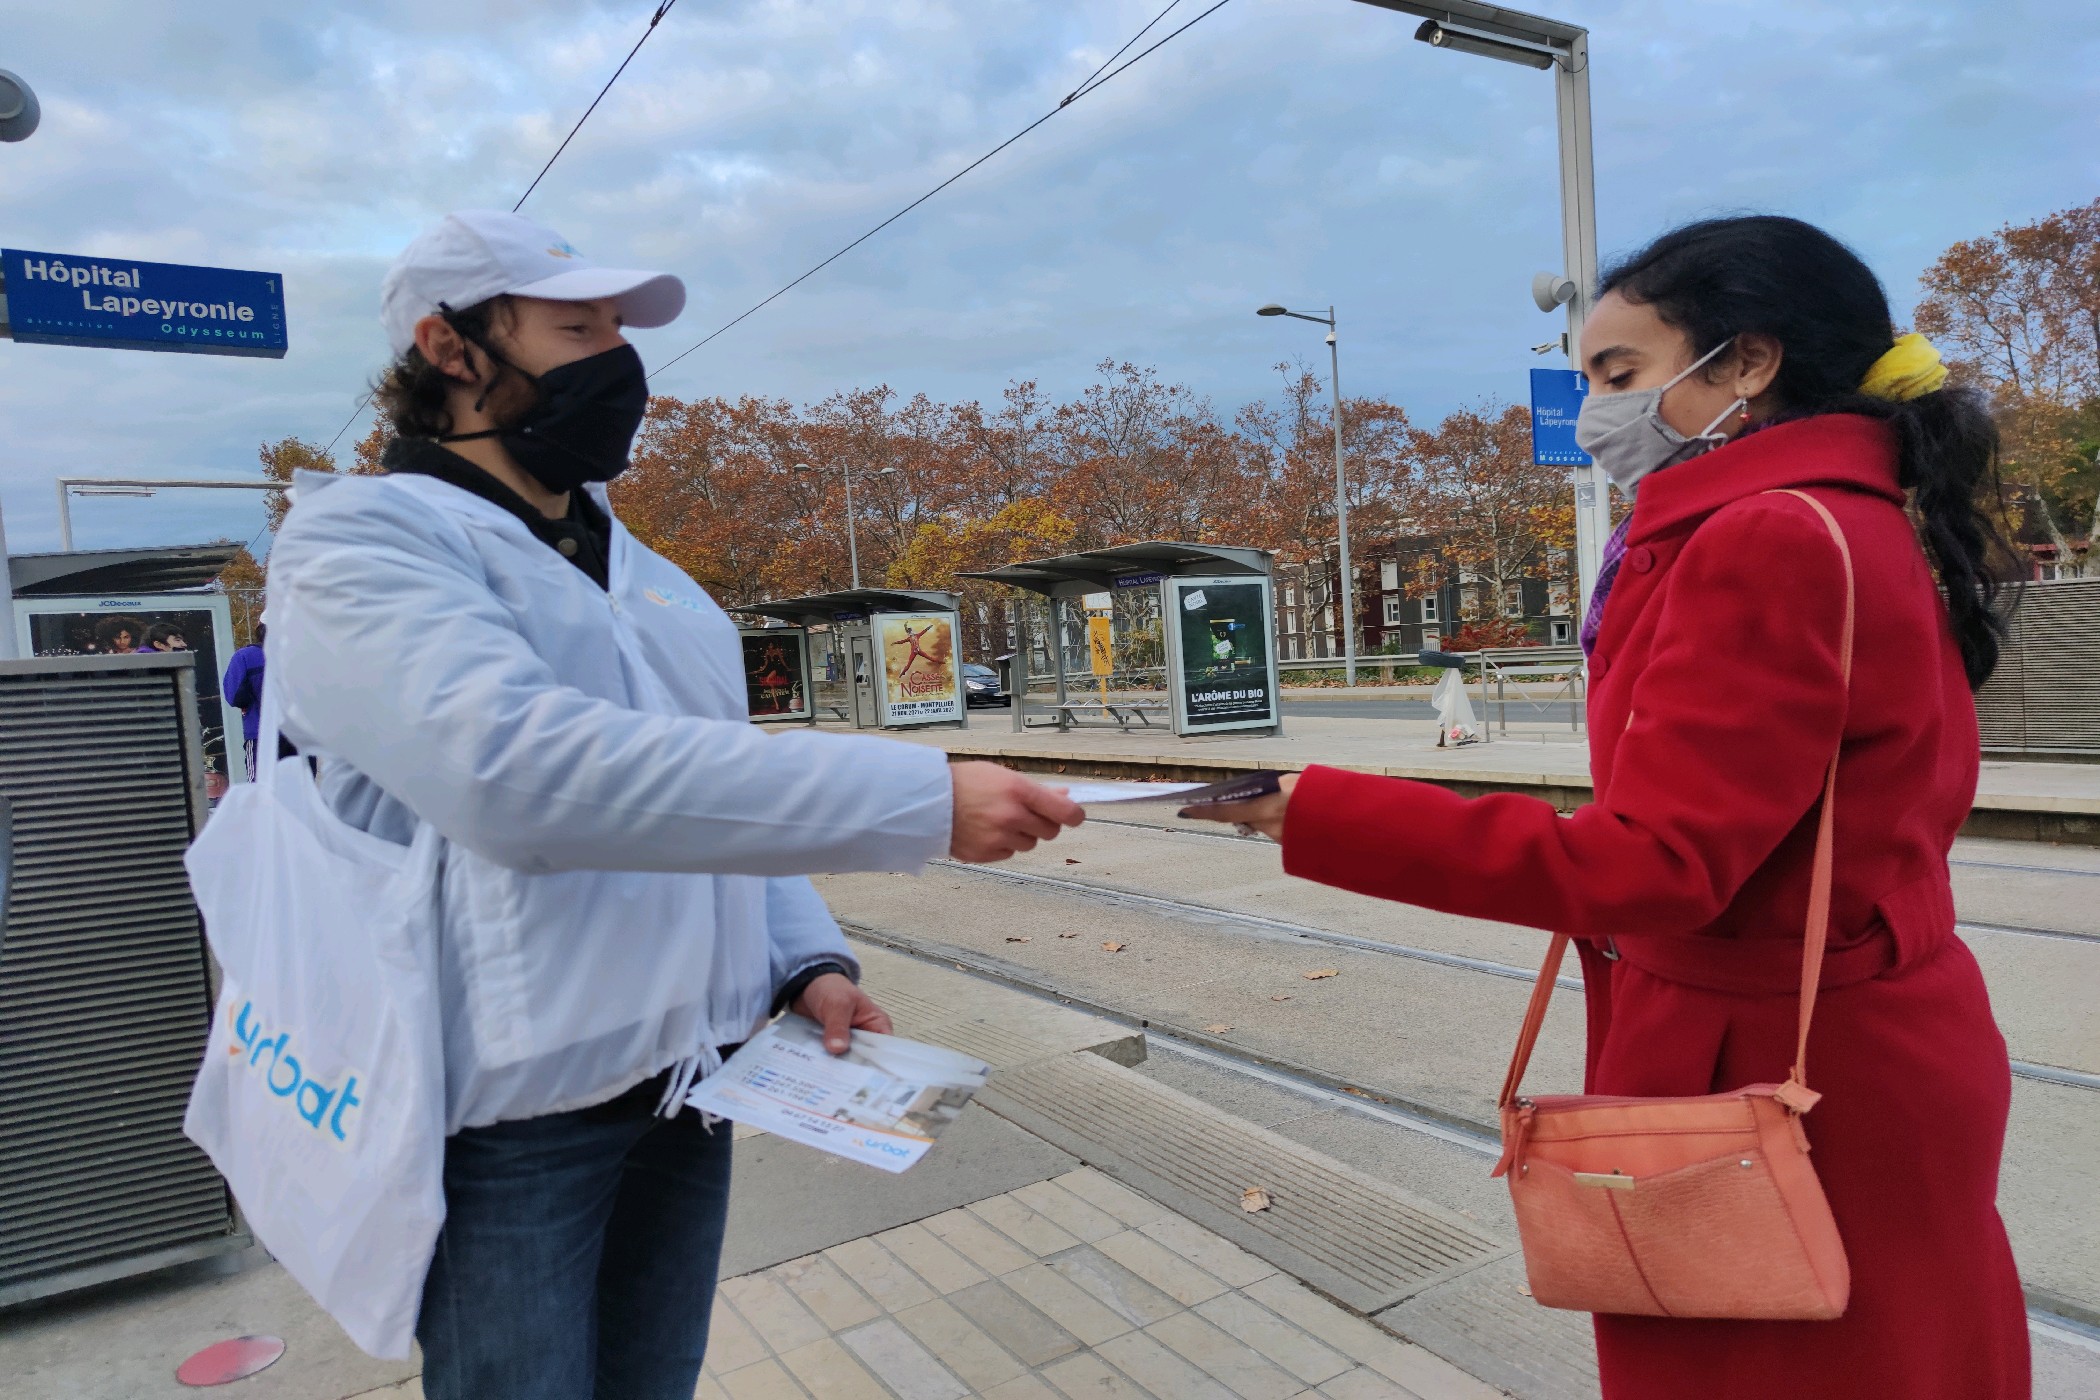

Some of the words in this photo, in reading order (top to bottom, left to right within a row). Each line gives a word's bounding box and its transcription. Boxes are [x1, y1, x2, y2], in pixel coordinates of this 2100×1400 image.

[24, 259, 140, 288] Hôpital
[266, 279, 275, 293] 1
[83, 290, 255, 322] Lapeyronie
[161, 323, 264, 340] Odysseum
[271, 304, 281, 344] LIGNE
[1536, 406, 1563, 418] Hôpital
[900, 682, 943, 697] NOISETTE
[1191, 689, 1232, 703] L'ARÔME
[1233, 690, 1246, 700] DU
[1247, 688, 1264, 699] BIO
[897, 703, 917, 711] CORUM
[236, 1000, 361, 1142] urbat
